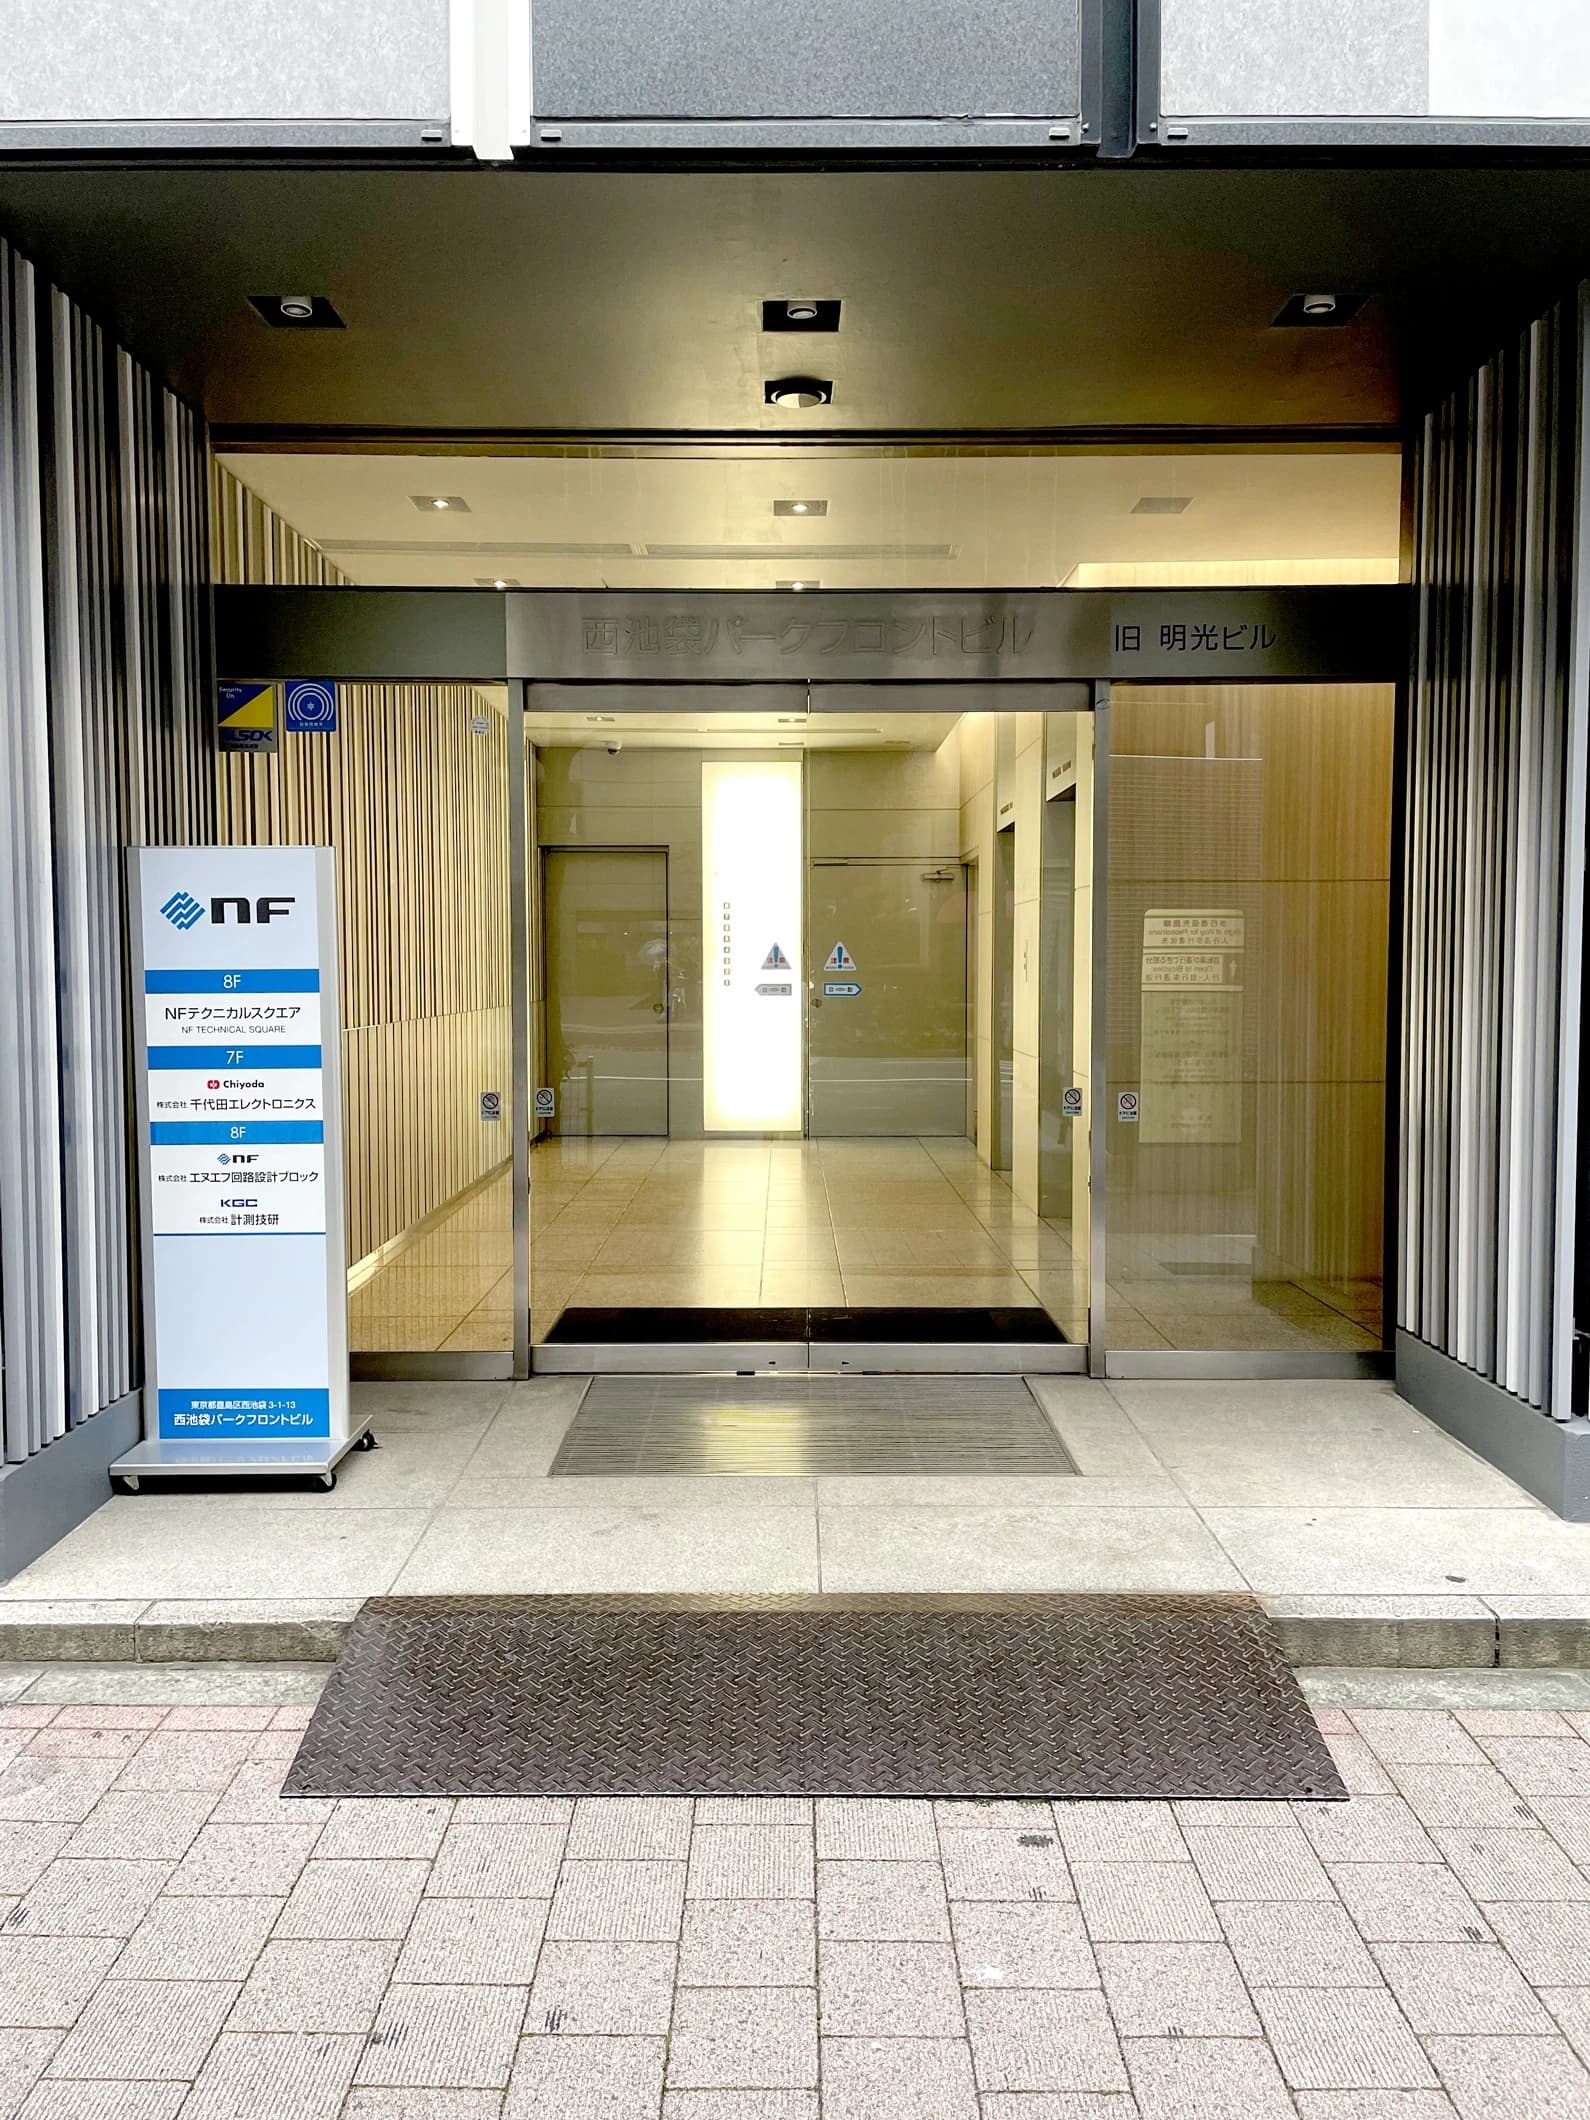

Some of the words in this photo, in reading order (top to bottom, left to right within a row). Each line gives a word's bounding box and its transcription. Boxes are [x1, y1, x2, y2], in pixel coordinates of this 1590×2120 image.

[582, 615, 1033, 656] 西池袋パークフロントビル
[1115, 624, 1141, 652] 旧
[1160, 623, 1277, 652] 明光ビル
[223, 974, 241, 989] 8F
[165, 1006, 302, 1021] NFテクニカルスクエア
[182, 1025, 194, 1035] NF
[196, 1024, 247, 1035] TECHNICAL
[249, 1024, 287, 1034] SQUARE
[226, 1050, 244, 1065] 7F
[223, 1079, 265, 1091] Chiyoda
[190, 1098, 317, 1111] 千代田エレクトロニクス
[230, 1126, 247, 1139] 8F
[189, 1171, 319, 1184] エヌエフ回路設計ブロック
[220, 1199, 259, 1208] KGC
[231, 1213, 280, 1226] 計測技研
[269, 1401, 296, 1410] 3-1-13
[173, 1413, 314, 1426] 西池袋パークフロントビル
